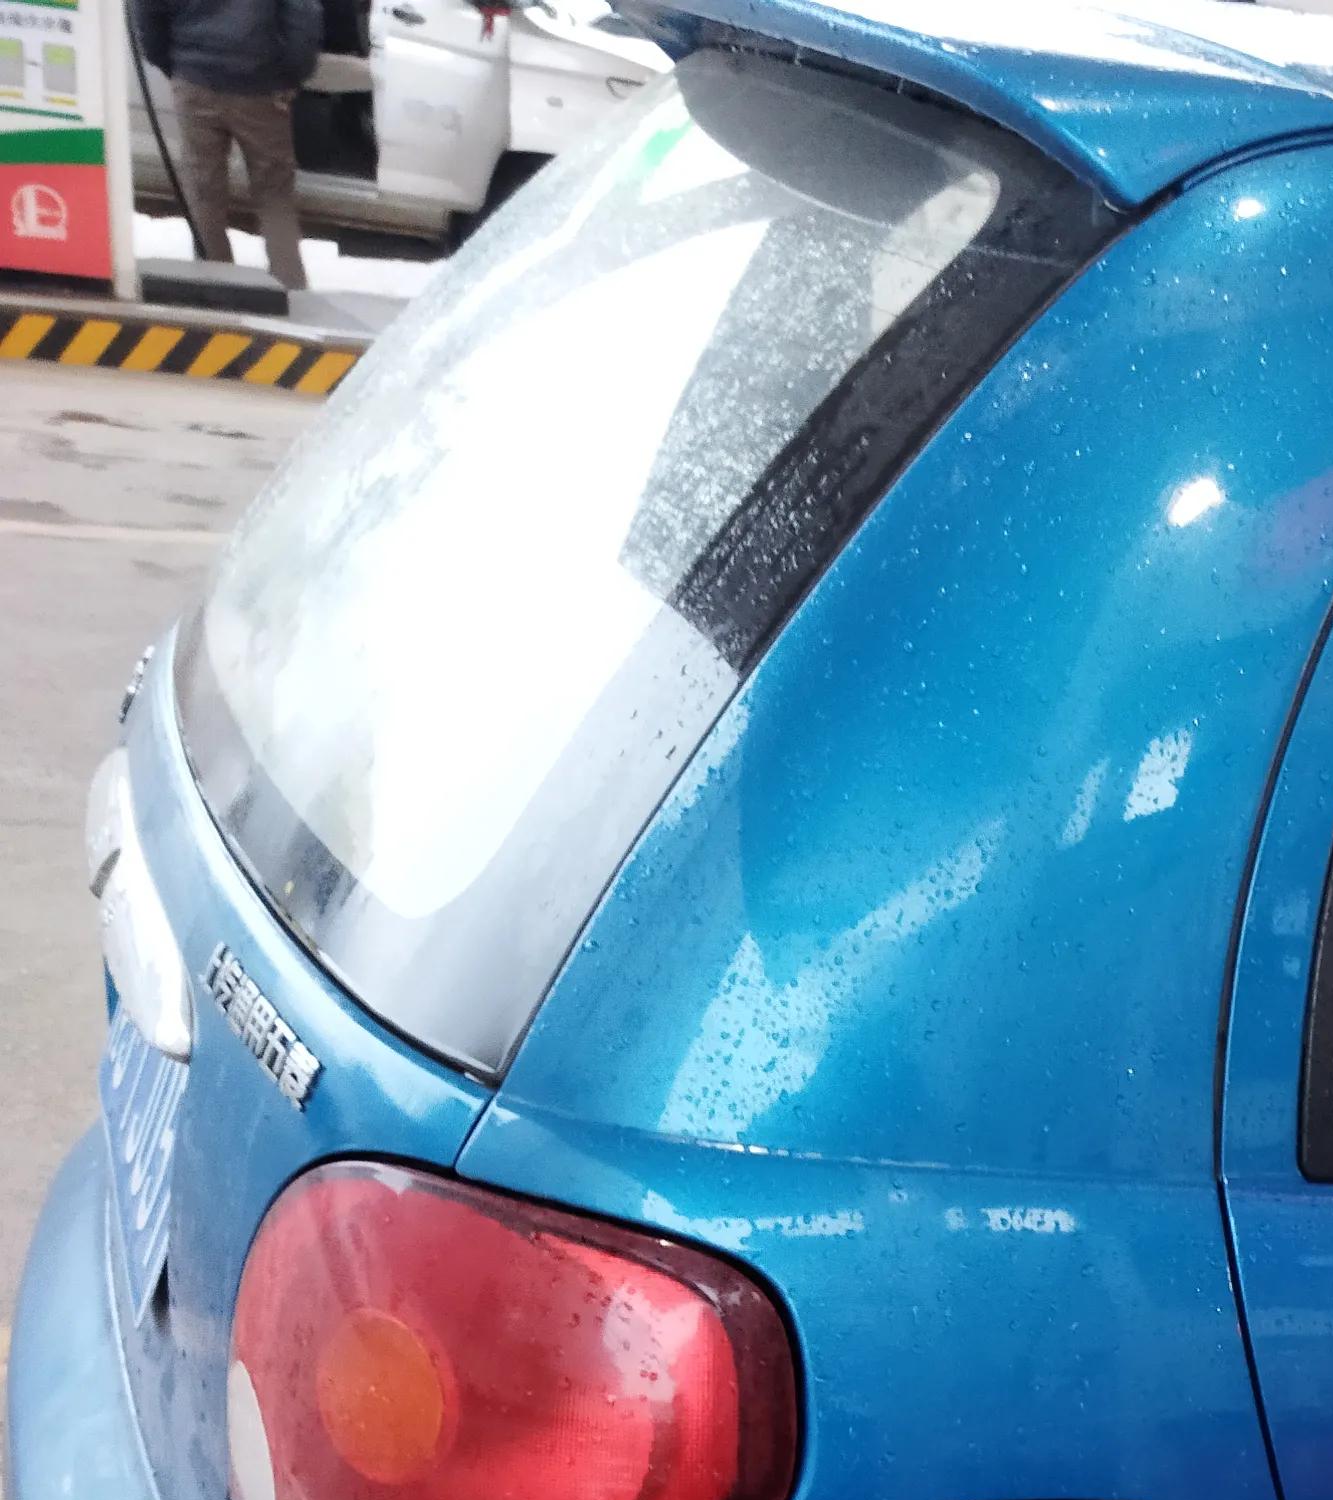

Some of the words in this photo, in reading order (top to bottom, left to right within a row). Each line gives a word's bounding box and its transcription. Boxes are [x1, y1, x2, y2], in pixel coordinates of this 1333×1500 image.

[198, 940, 322, 1112] 上汽通用五菱
